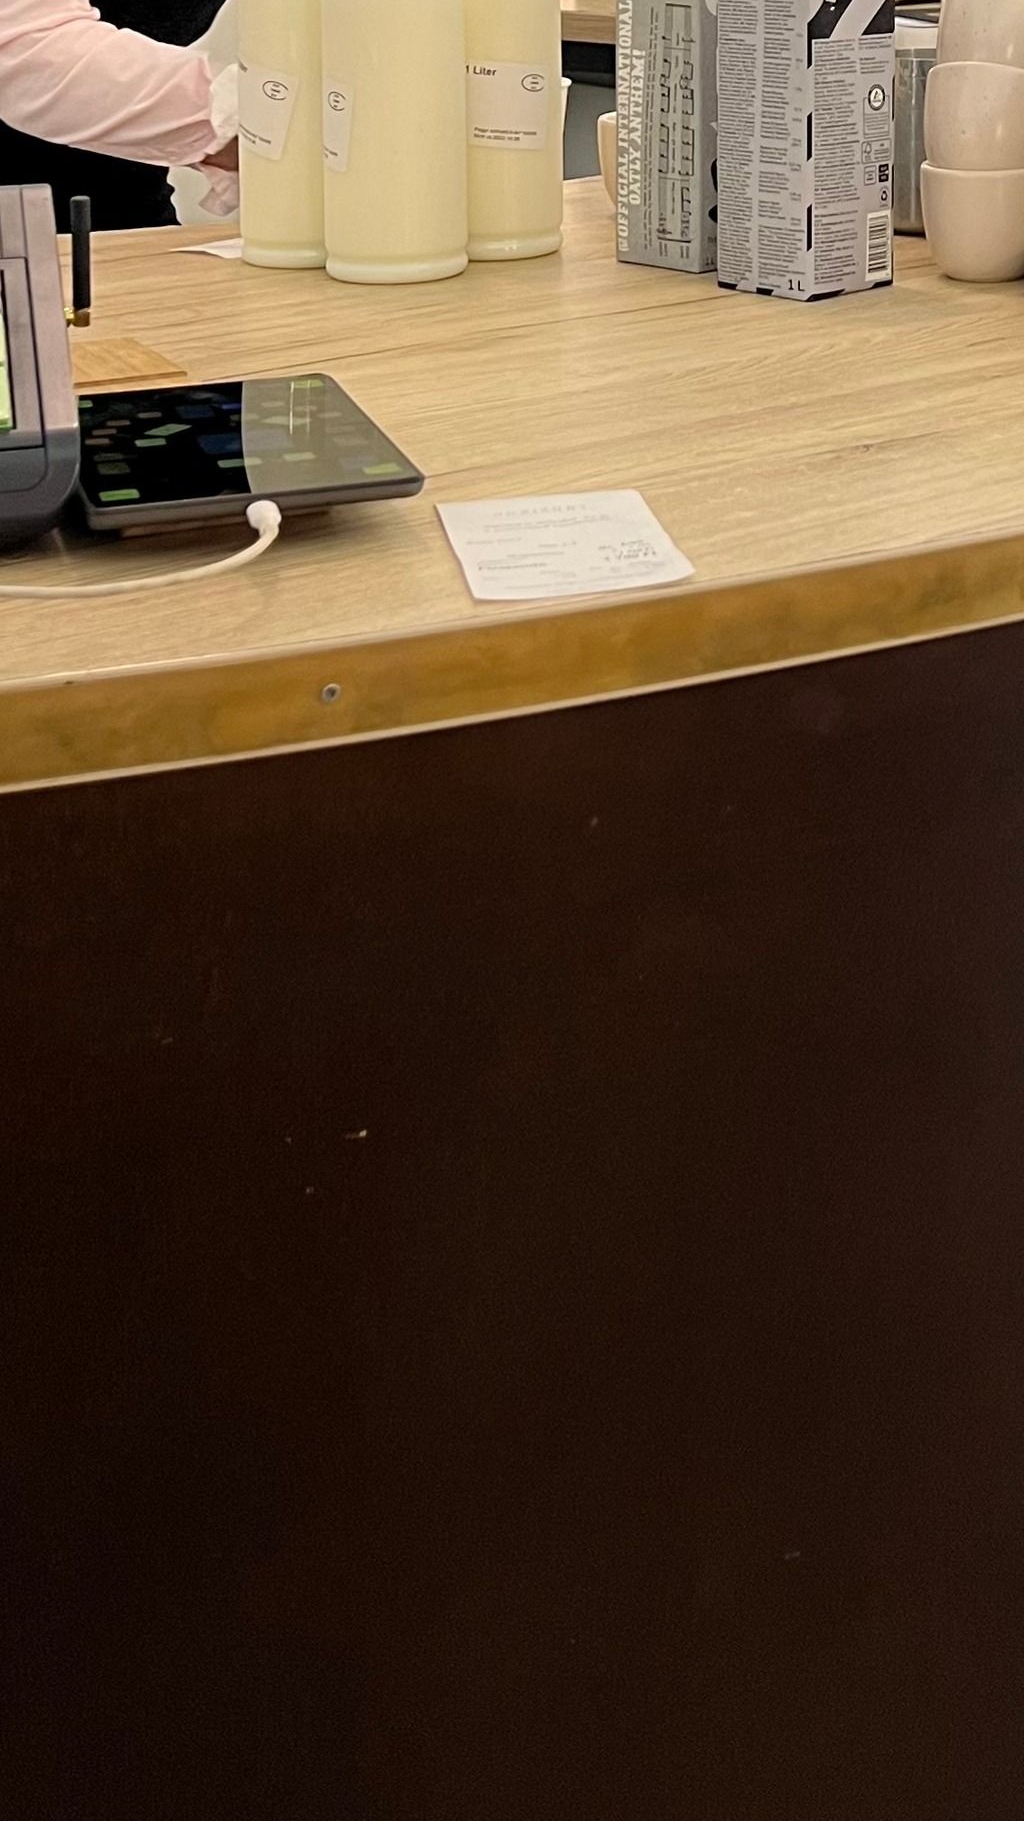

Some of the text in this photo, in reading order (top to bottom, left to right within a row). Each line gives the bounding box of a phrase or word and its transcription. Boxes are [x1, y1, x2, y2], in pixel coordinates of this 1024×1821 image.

[473, 66, 497, 76] Liter
[618, 0, 633, 149] INTERNATIONAL
[628, 49, 646, 205] OATLY ANTHEM!
[618, 153, 629, 237] OFFICIAL
[788, 279, 805, 292] 1 L
